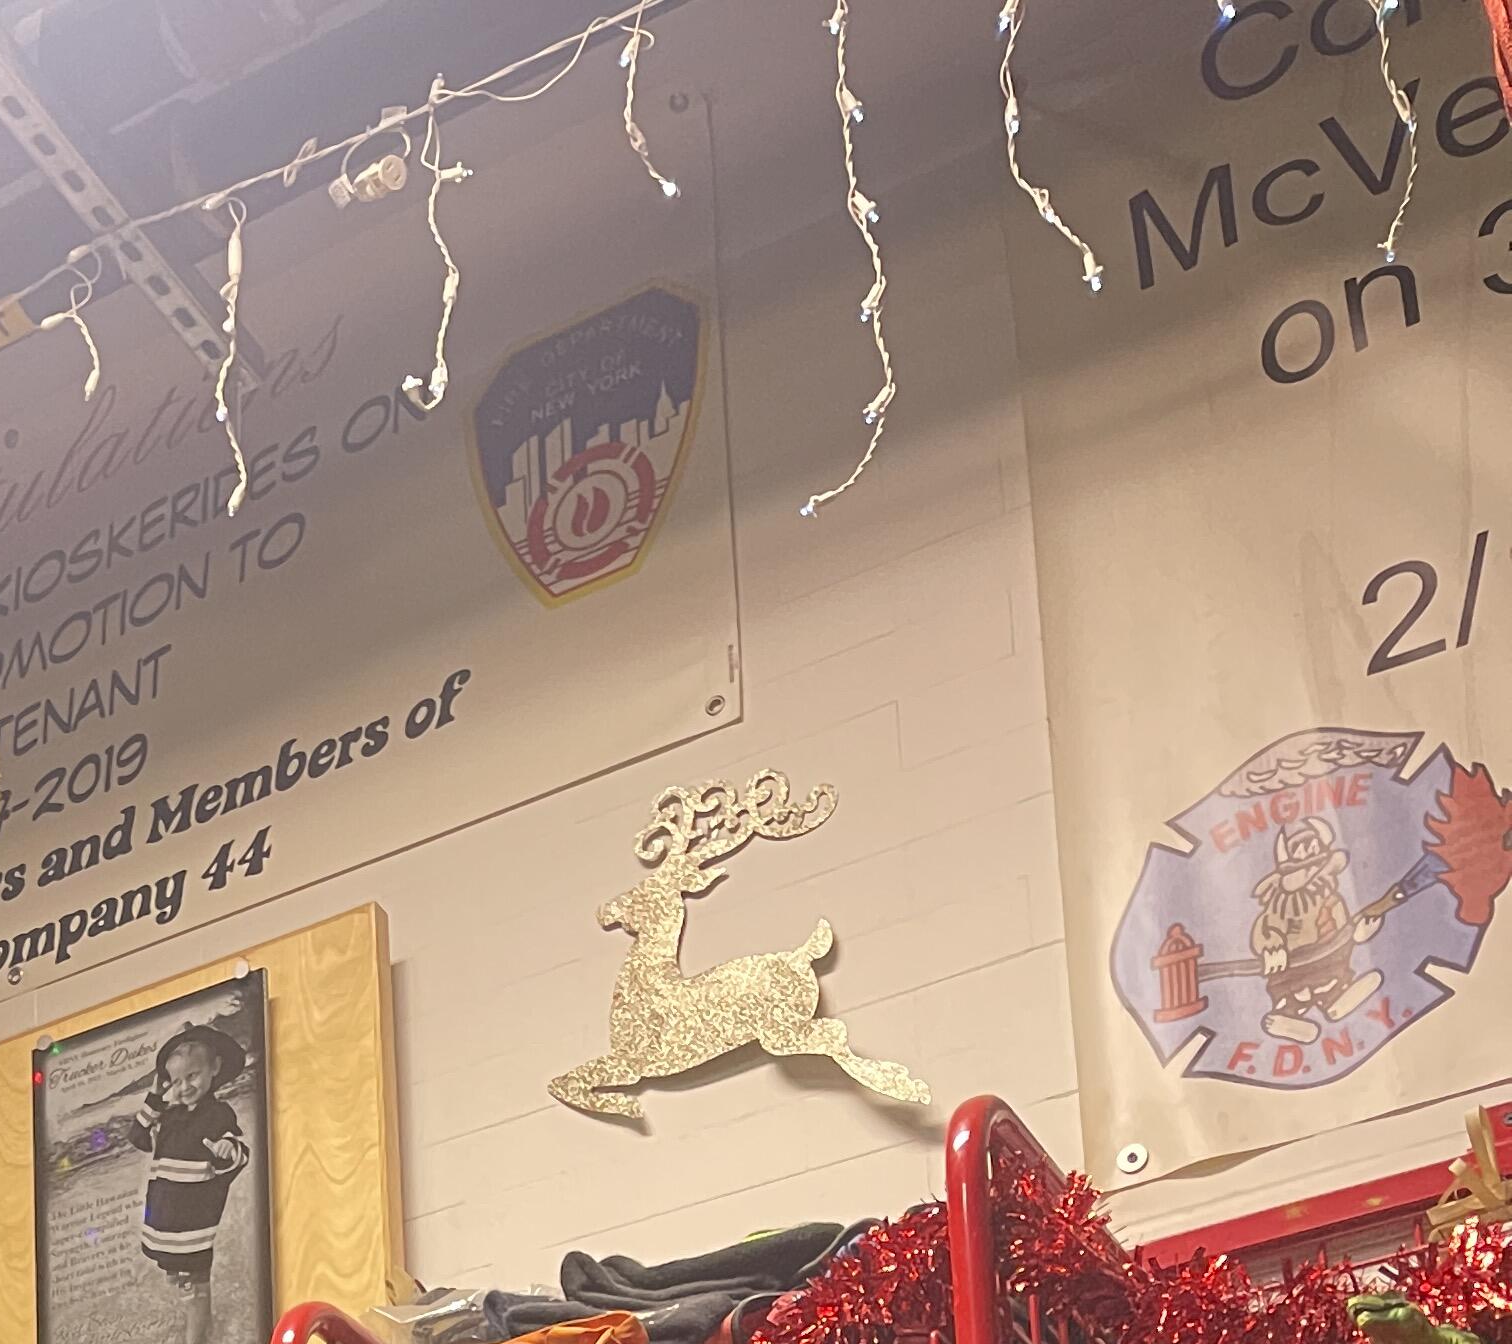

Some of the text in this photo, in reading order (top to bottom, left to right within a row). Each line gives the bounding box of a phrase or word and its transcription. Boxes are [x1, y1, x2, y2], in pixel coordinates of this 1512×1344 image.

[1201, 0, 1422, 100] Co
[1261, 264, 1420, 384] on
[531, 361, 640, 423] NEW YORK
[230, 512, 306, 584] TO
[37, 805, 136, 888] and
[144, 715, 391, 846] Members
[404, 668, 472, 740] of
[1209, 773, 1373, 853] ENGINE
[201, 825, 273, 892] 44
